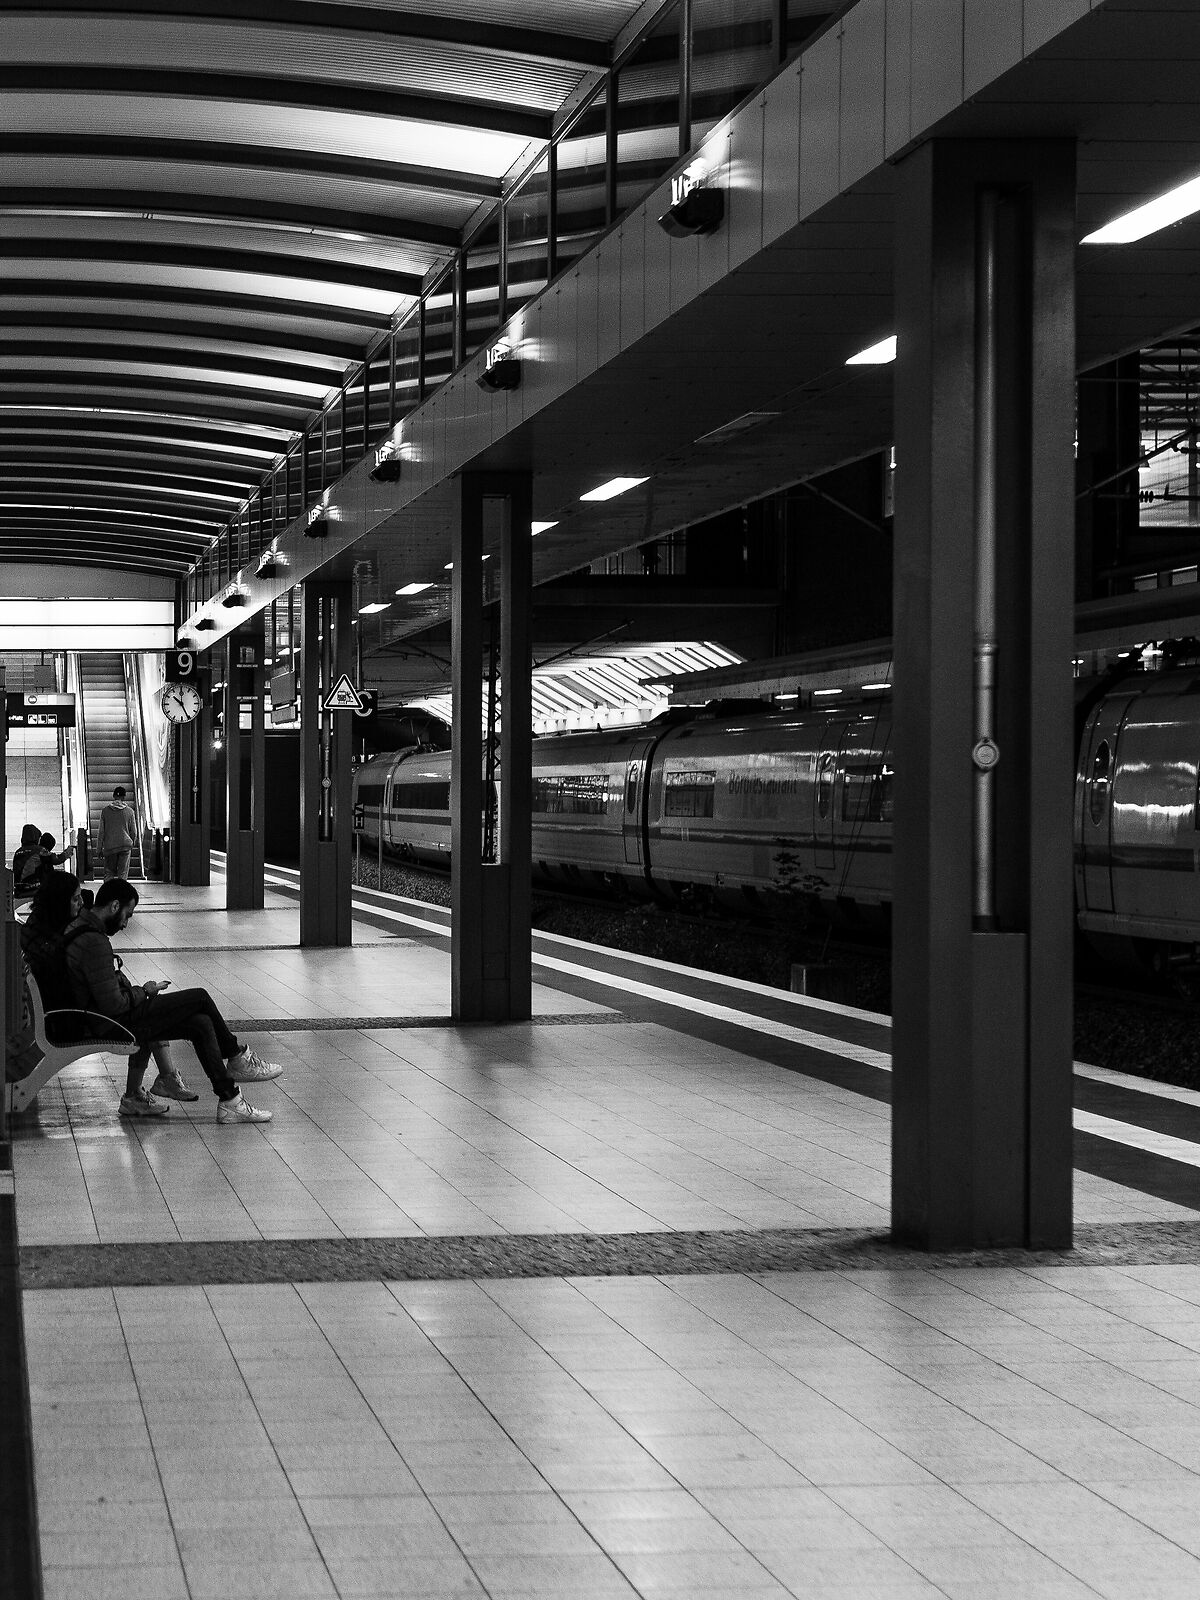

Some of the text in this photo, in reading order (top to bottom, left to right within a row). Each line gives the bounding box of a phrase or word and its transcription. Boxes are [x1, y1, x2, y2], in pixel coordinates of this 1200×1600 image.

[177, 652, 193, 675] 9
[355, 691, 373, 717] C
[355, 816, 363, 827] H
